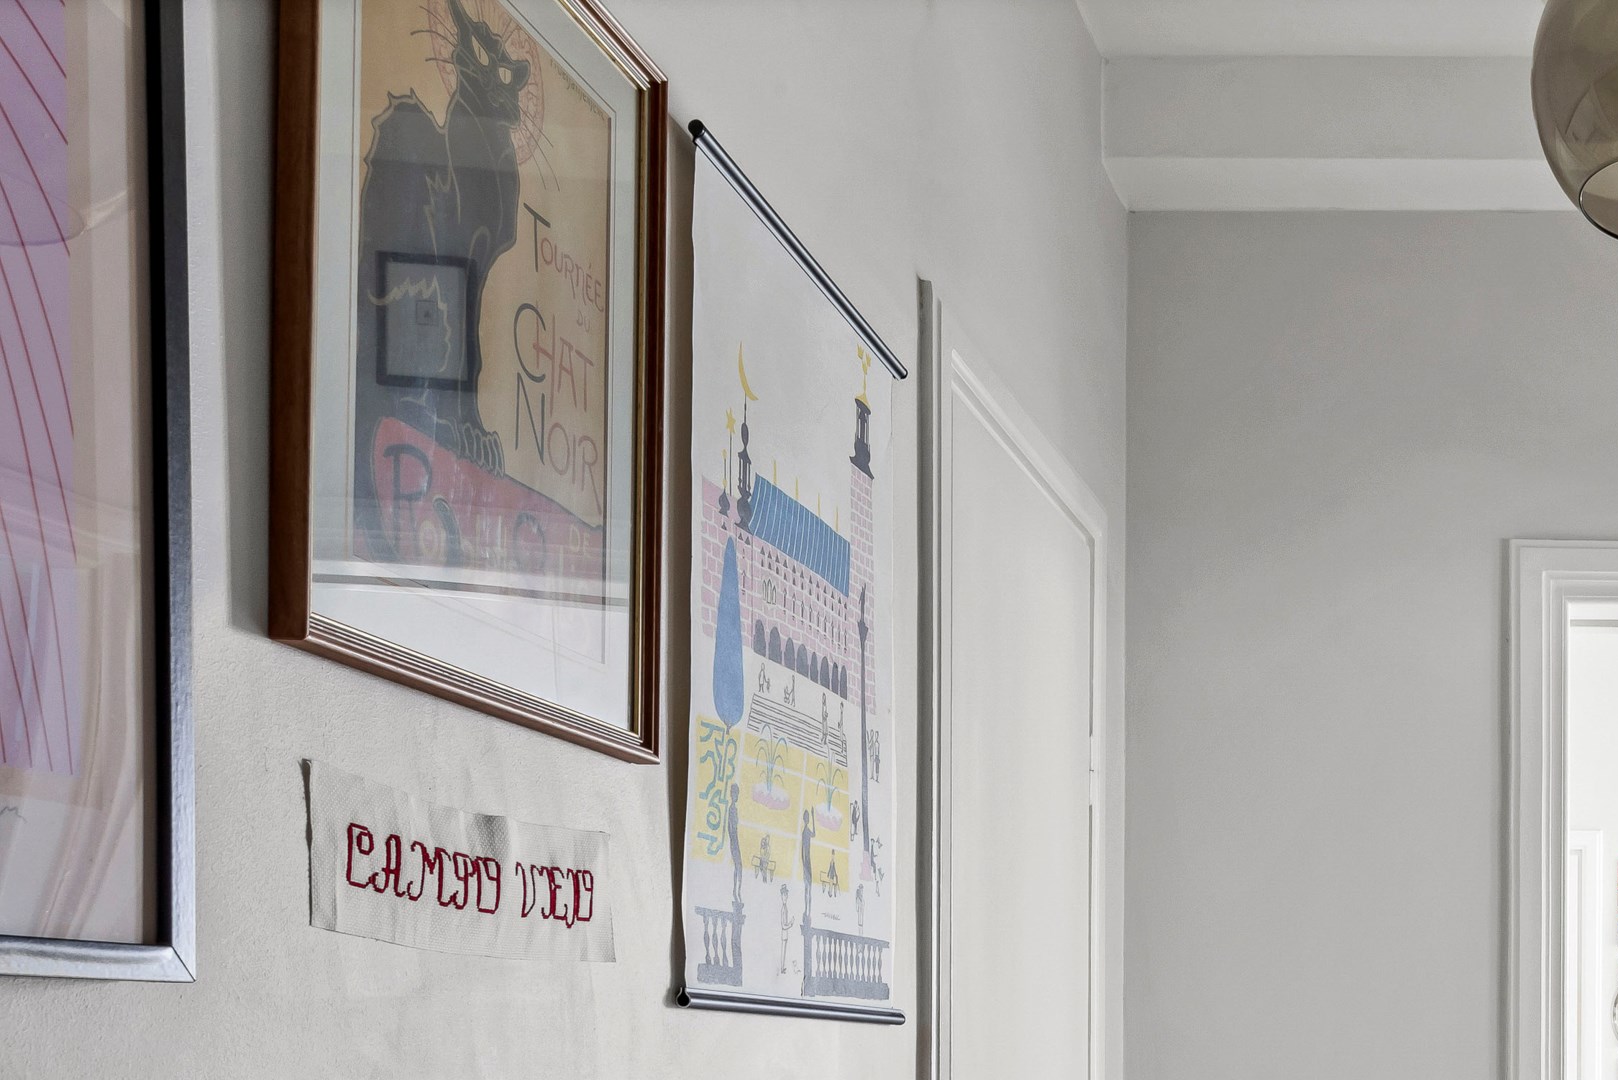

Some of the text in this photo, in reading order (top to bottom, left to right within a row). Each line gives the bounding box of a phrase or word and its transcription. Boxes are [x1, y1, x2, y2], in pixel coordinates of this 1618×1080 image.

[523, 202, 604, 312] TOURNÉE
[514, 301, 595, 419] CHAT
[576, 312, 592, 334] DU
[514, 371, 603, 516] NOIR
